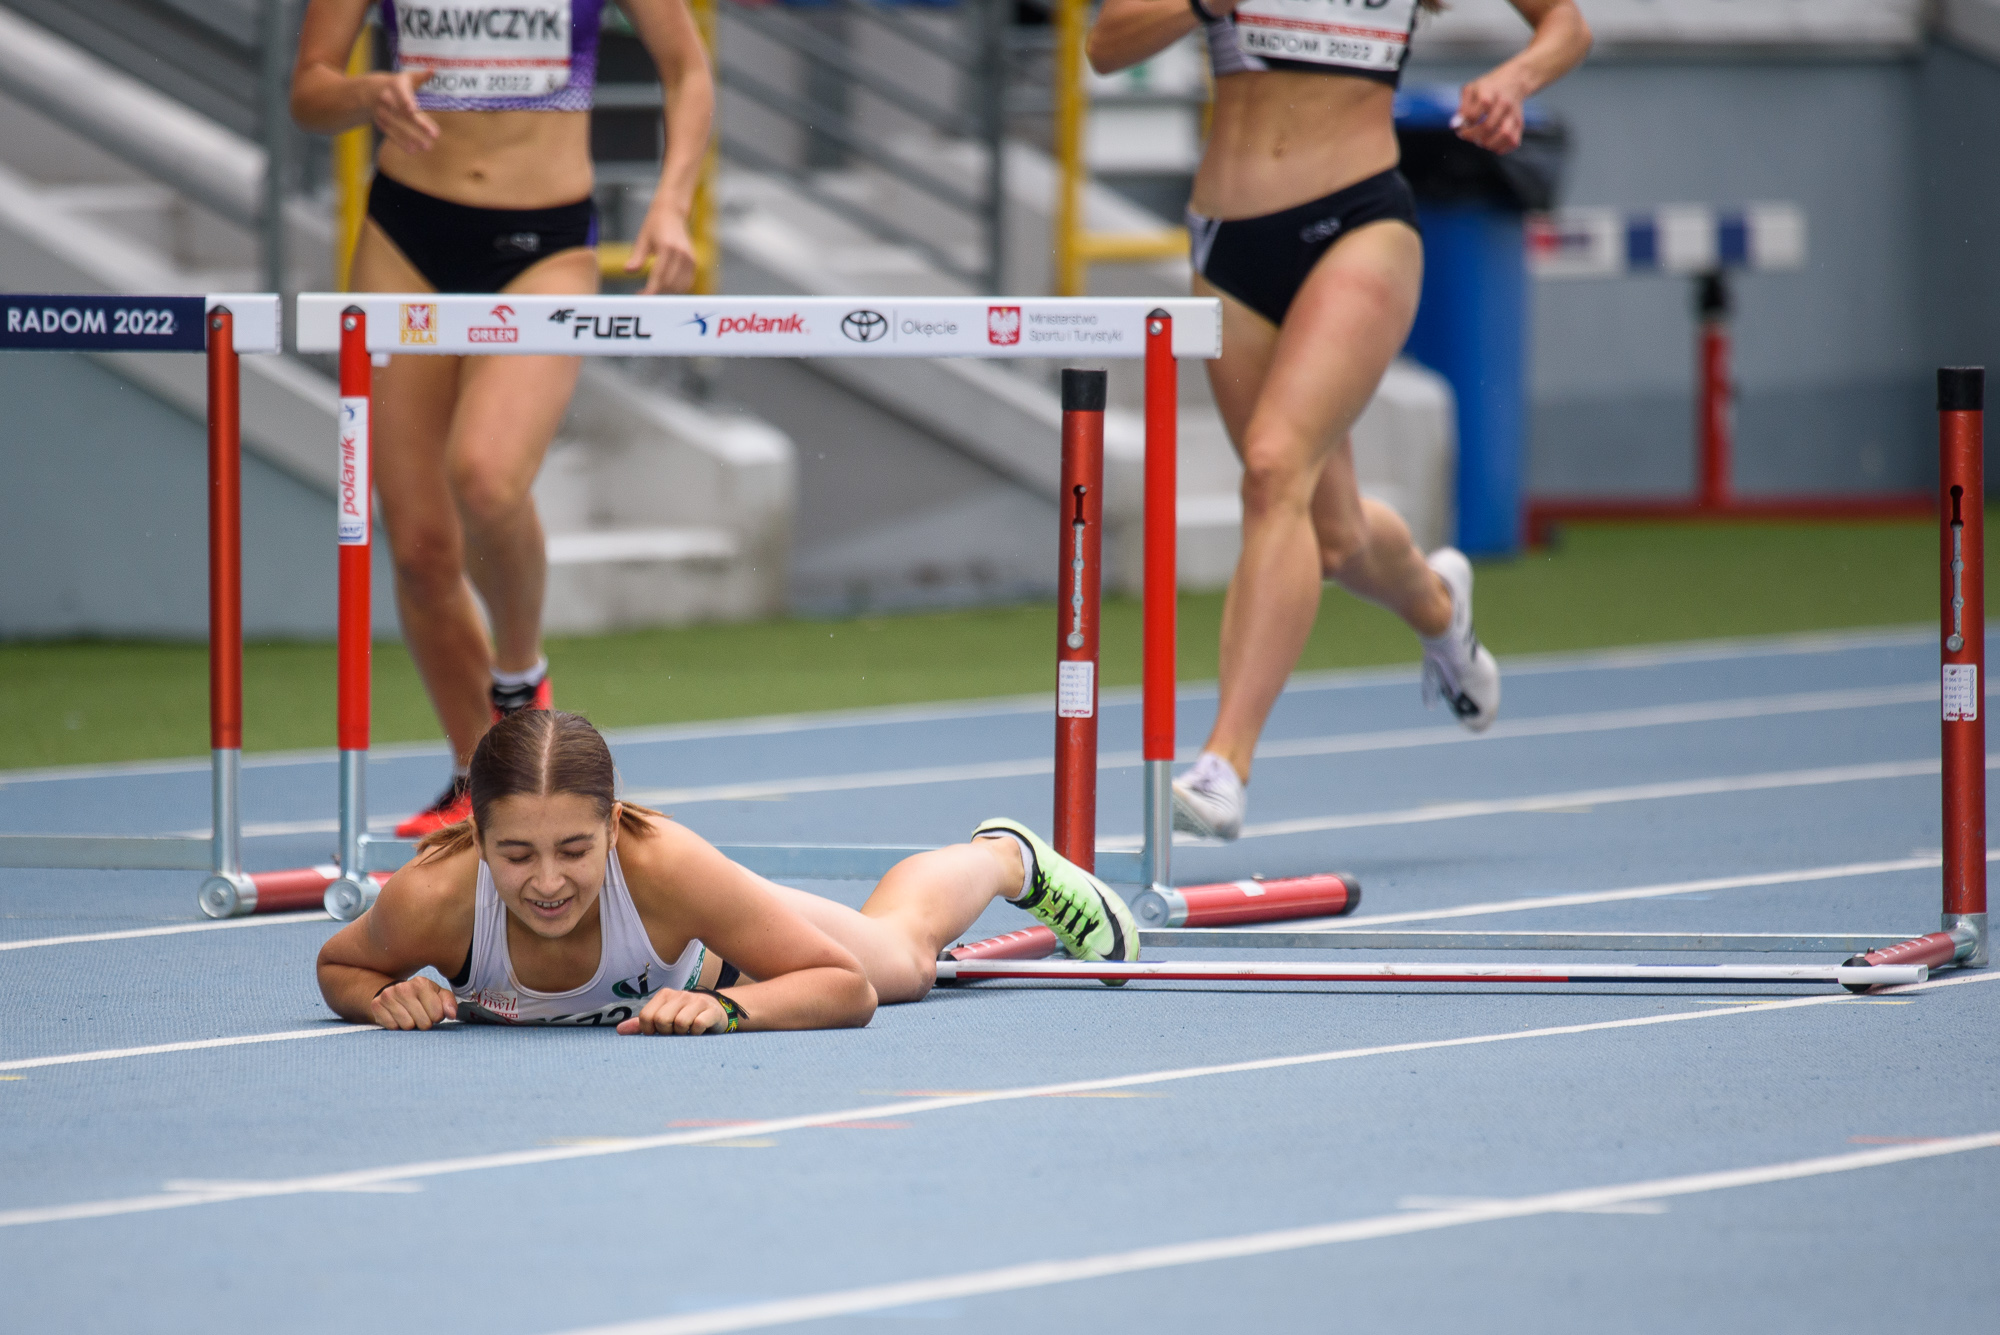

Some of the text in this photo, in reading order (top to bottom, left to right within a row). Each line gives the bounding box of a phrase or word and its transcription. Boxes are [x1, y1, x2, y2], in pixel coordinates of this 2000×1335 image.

[402, 8, 561, 40] KRAWCZYK
[1327, 39, 1373, 61] 2022
[486, 75, 532, 92] 2022
[7, 307, 174, 335] RADOM 2022
[573, 316, 651, 339] FUEL
[716, 312, 806, 338] polanik
[901, 319, 958, 338] Okęcie
[1028, 313, 1098, 326] Ministerstwo
[470, 329, 516, 342] ORLEN
[340, 434, 360, 517] polanik
